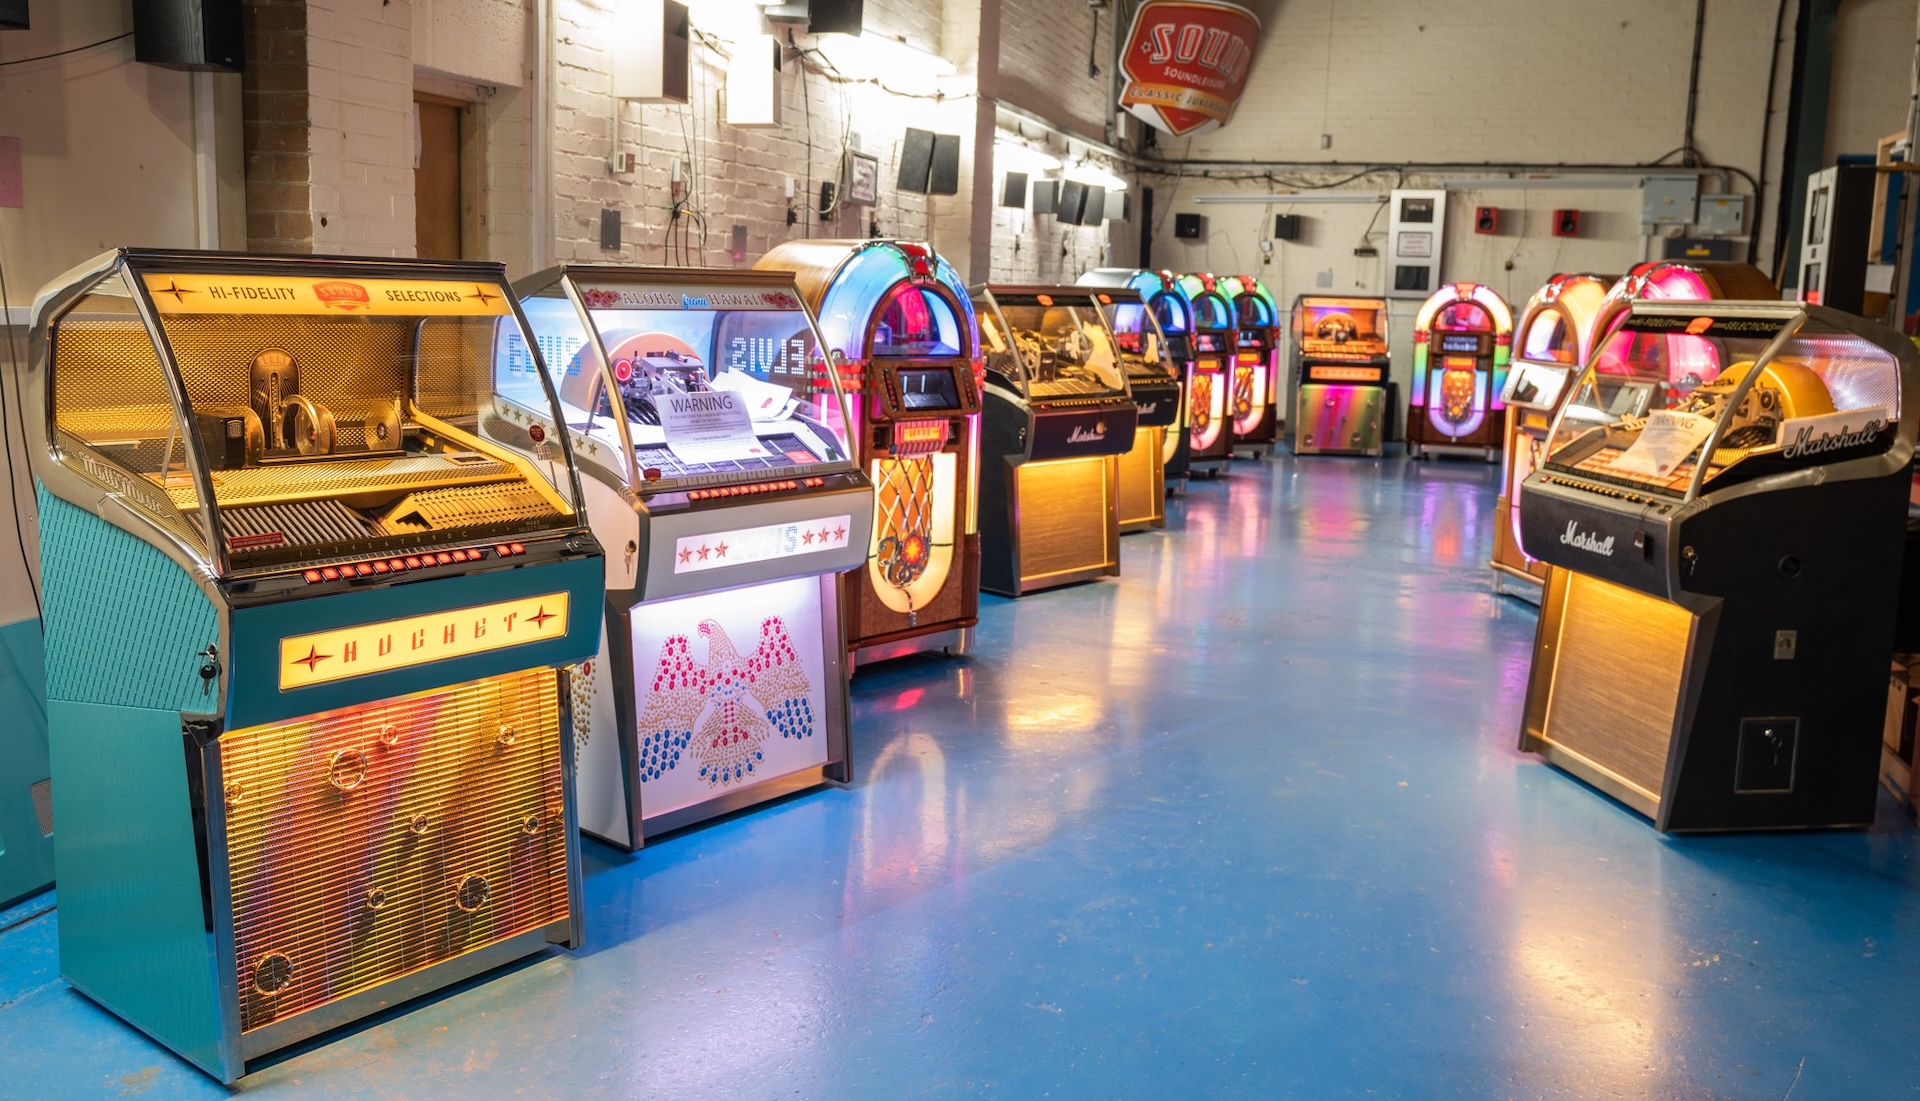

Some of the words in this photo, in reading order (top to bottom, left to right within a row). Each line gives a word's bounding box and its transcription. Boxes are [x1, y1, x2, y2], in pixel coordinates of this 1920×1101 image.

[209, 286, 295, 300] HI-FIDELITY
[386, 289, 461, 302] SELECTIONS
[622, 291, 678, 306] ALOHA
[682, 293, 710, 310] from
[707, 292, 763, 306] HAWAII
[1724, 321, 1775, 332] SELECTIONS
[670, 395, 733, 413] WARNING
[1783, 419, 1888, 458] Marshall
[1560, 520, 1615, 556] Marshall
